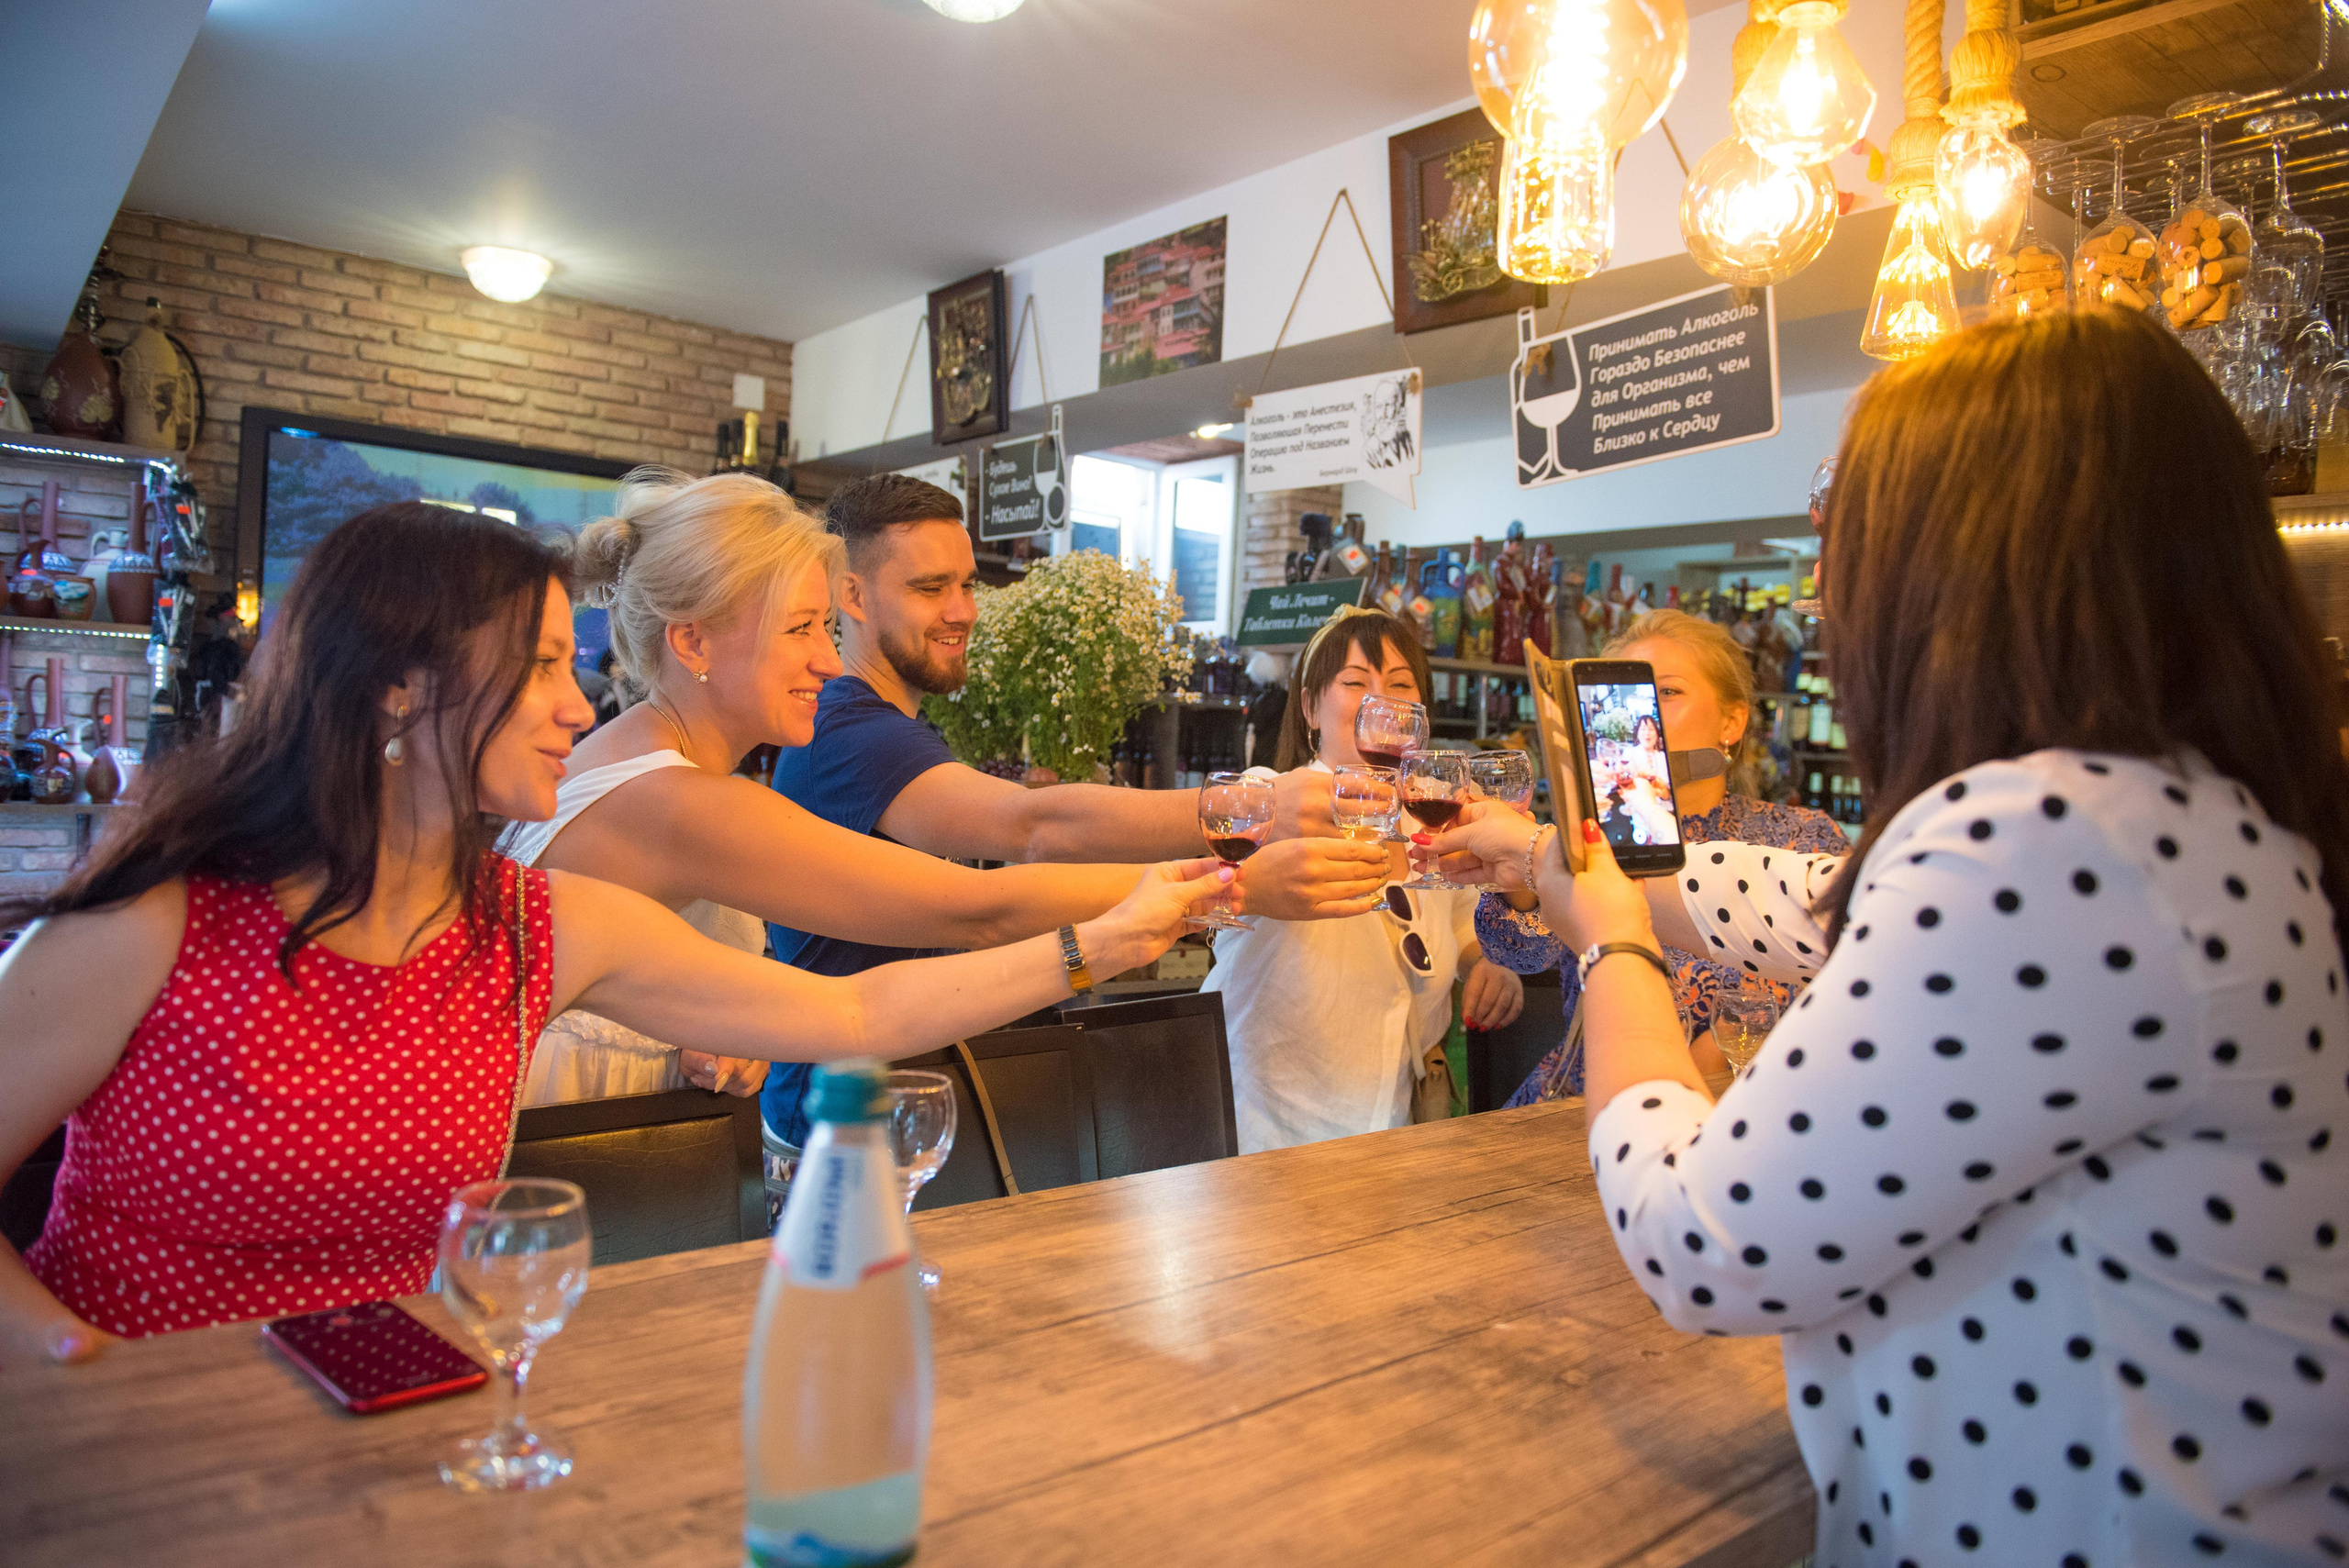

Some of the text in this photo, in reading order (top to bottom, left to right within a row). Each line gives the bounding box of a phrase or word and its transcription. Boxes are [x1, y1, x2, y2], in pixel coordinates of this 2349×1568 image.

[1588, 303, 1759, 362] Принимать Алкоголь
[1589, 330, 1747, 385] Гораздо Безопаснее
[1590, 355, 1751, 407] для Организма, чем
[1304, 420, 1349, 434] Перенести
[1592, 389, 1714, 432] Принимать все
[1305, 438, 1350, 450] Названием
[1593, 412, 1721, 455] Близко к Сердцу
[991, 499, 1040, 524] Насыпай!
